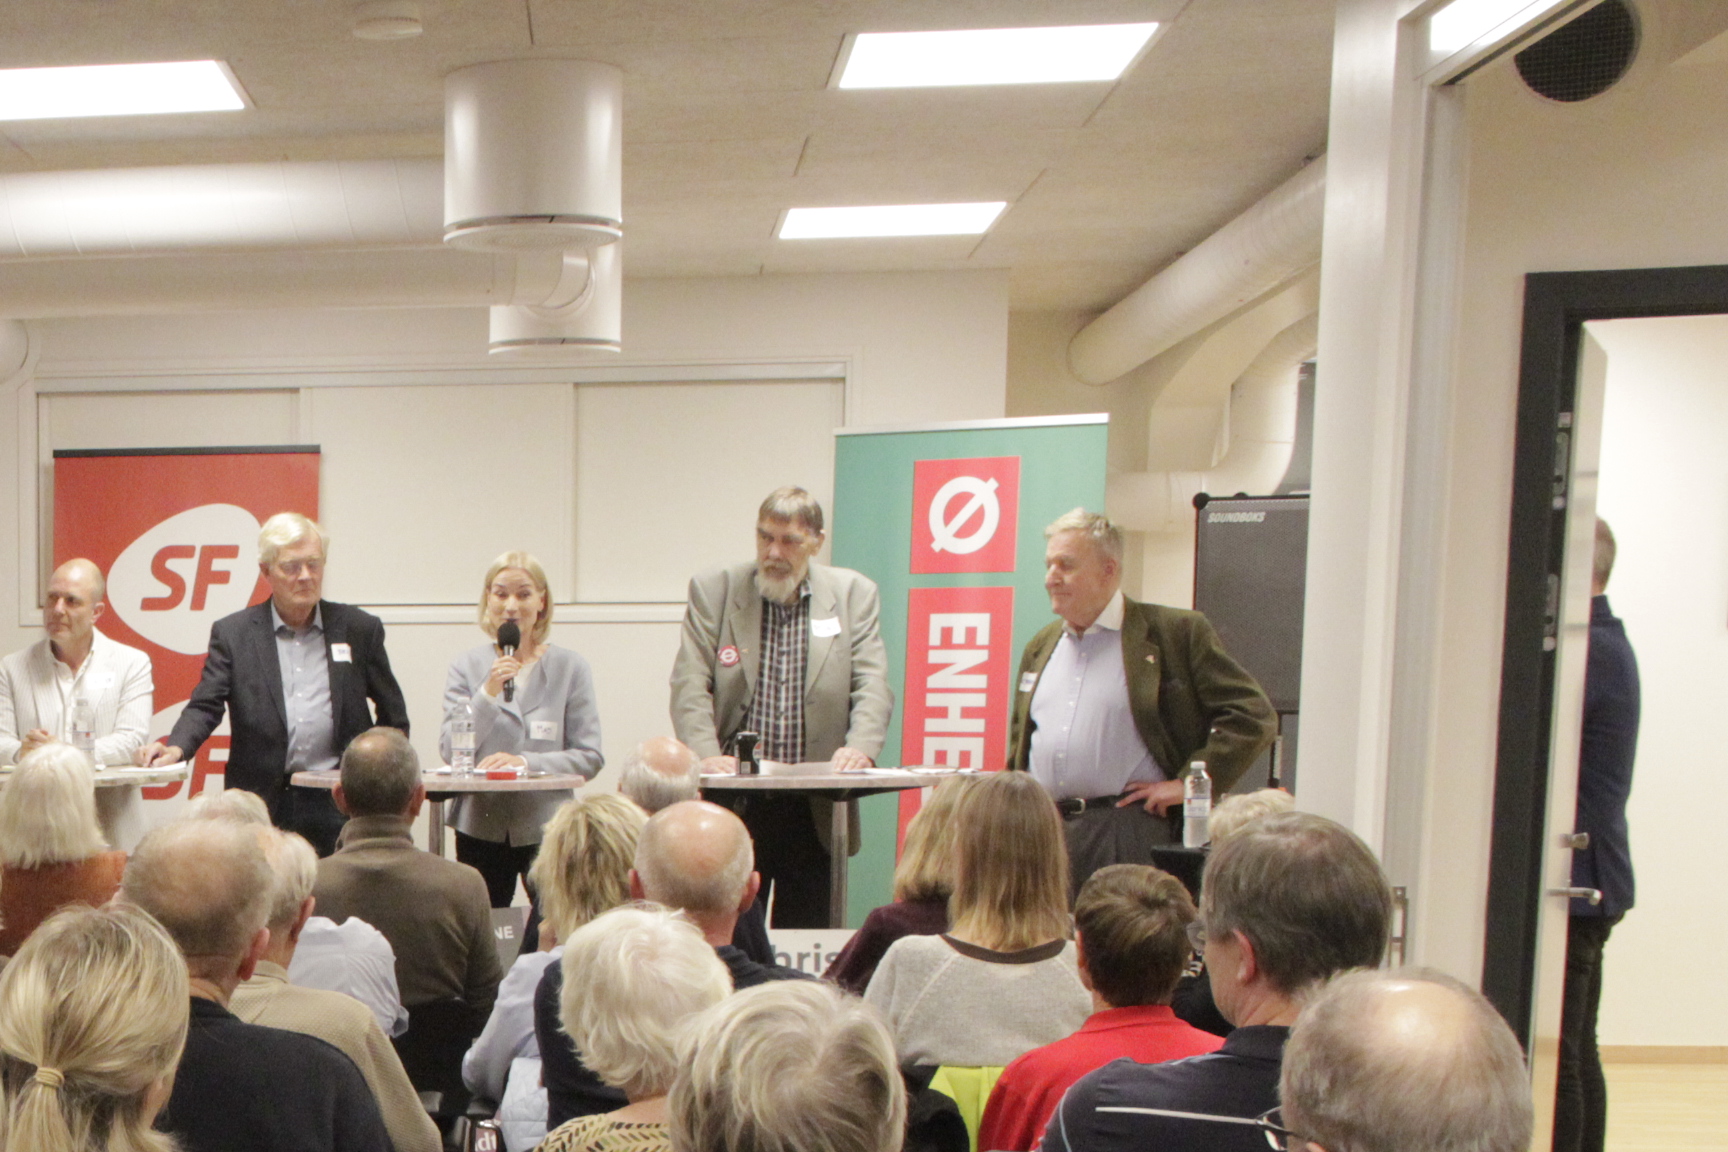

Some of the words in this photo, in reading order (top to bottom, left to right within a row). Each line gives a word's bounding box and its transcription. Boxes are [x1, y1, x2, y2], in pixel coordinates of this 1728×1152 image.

[928, 475, 1000, 554] Ø
[1207, 511, 1266, 523] SOUNDBOKS
[140, 545, 239, 611] SF
[922, 612, 991, 808] ENHE
